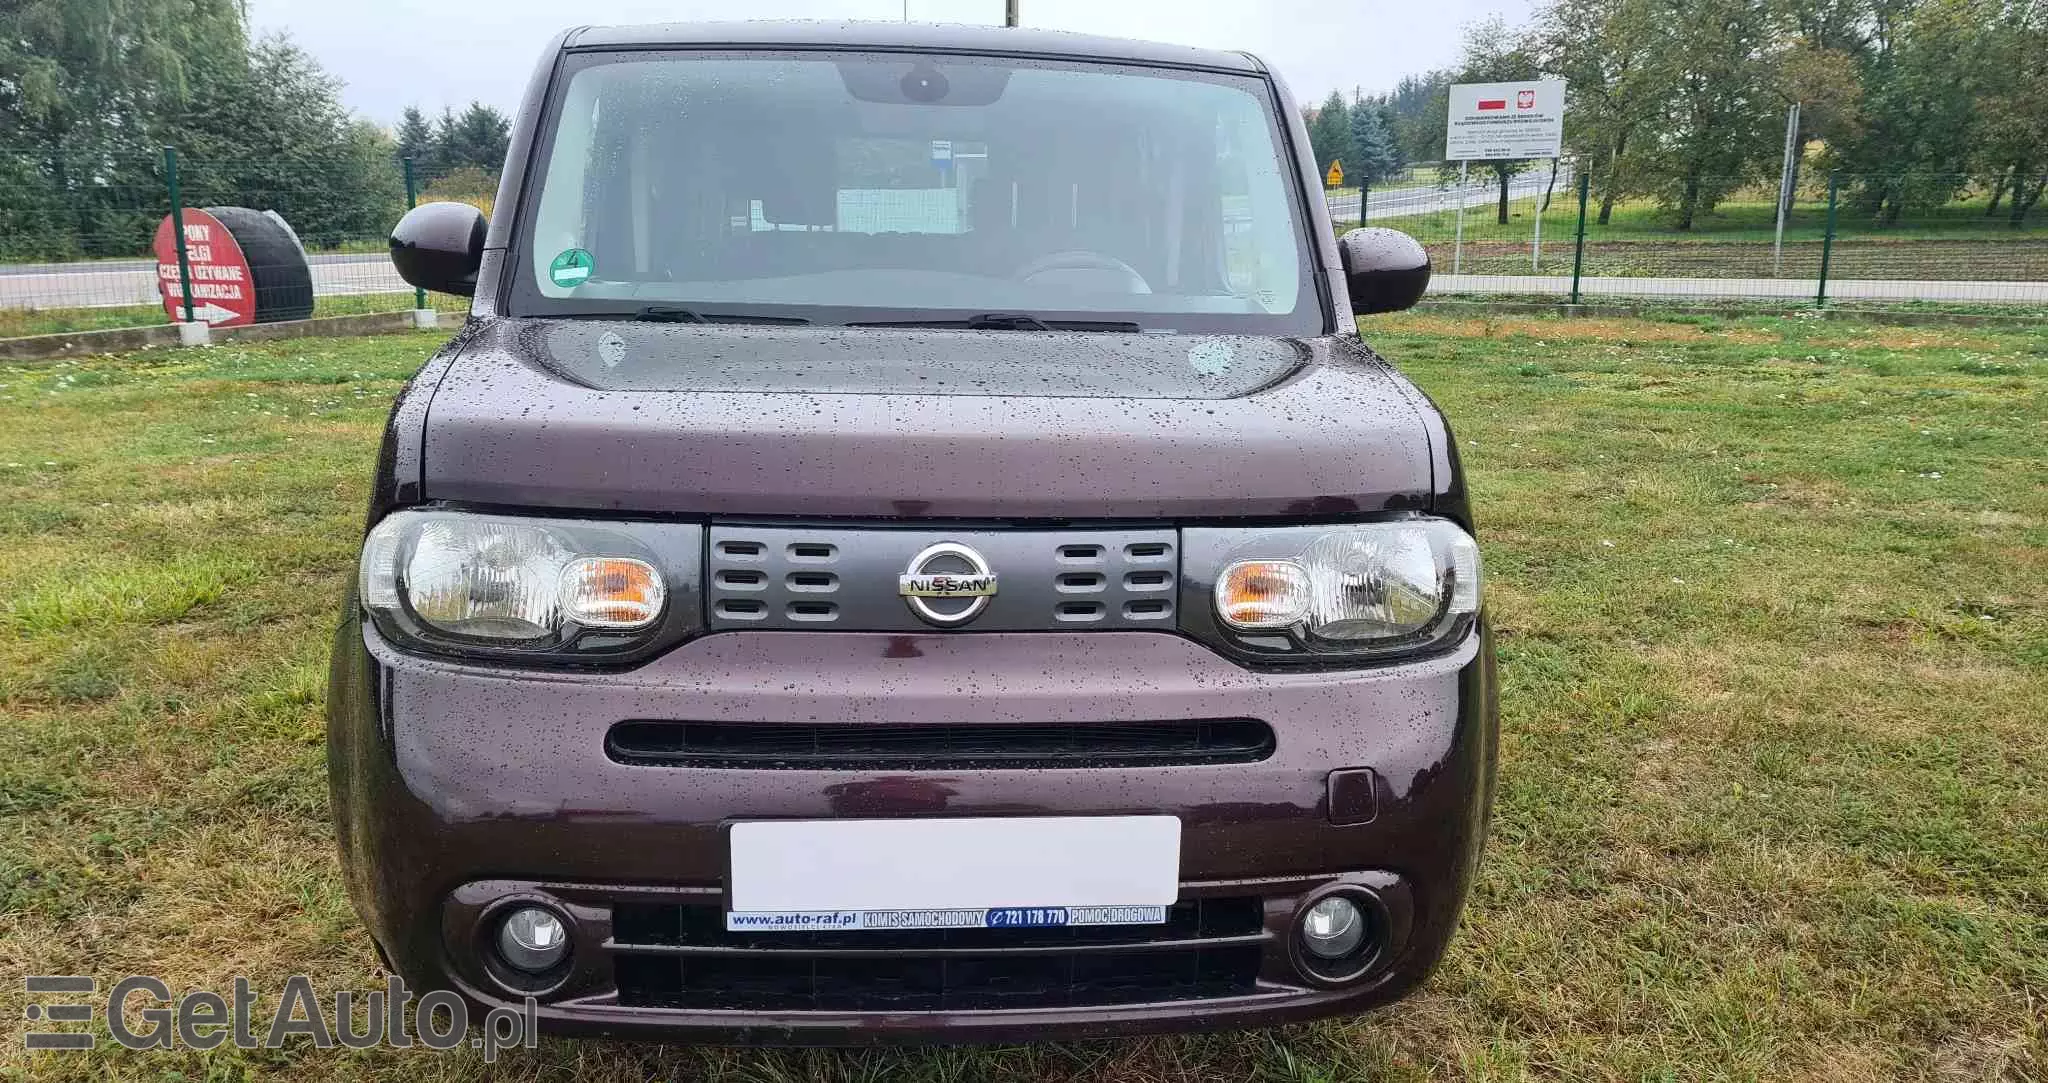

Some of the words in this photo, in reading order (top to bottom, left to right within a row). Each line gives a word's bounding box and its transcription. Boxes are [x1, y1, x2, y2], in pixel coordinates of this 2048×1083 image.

[567, 250, 579, 268] 4
[910, 579, 987, 592] NISSAN
[733, 911, 857, 926] www.auto-raf.pl
[863, 912, 900, 927] KOMIS
[900, 910, 984, 927] SAMOCHODOWY
[1005, 908, 1023, 924] 721
[1026, 908, 1044, 924] 178
[1046, 908, 1065, 923] 770
[1071, 907, 1109, 922] POMOC
[1109, 906, 1161, 921] DROGOWA
